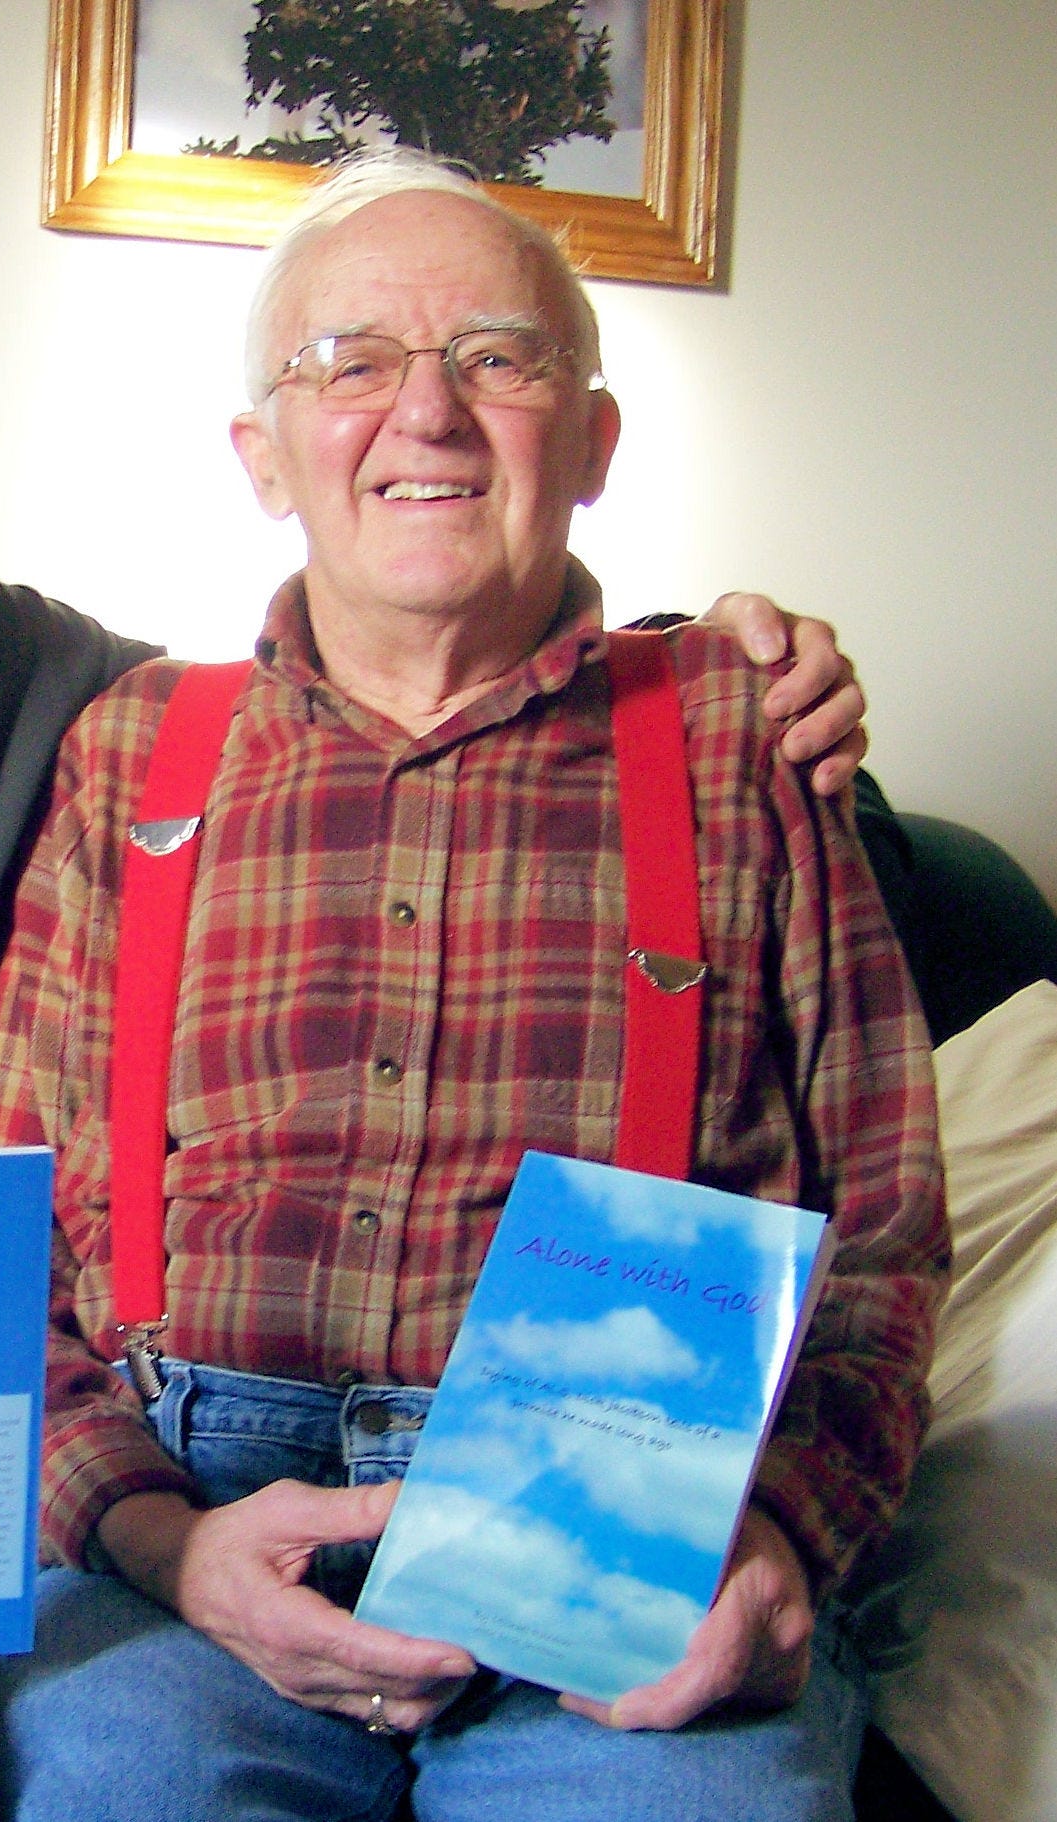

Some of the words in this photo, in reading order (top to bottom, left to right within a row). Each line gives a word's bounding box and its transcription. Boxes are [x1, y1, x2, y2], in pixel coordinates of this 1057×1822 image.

[515, 1236, 612, 1276] Alone
[621, 1259, 690, 1296] with
[703, 1284, 771, 1314] God
